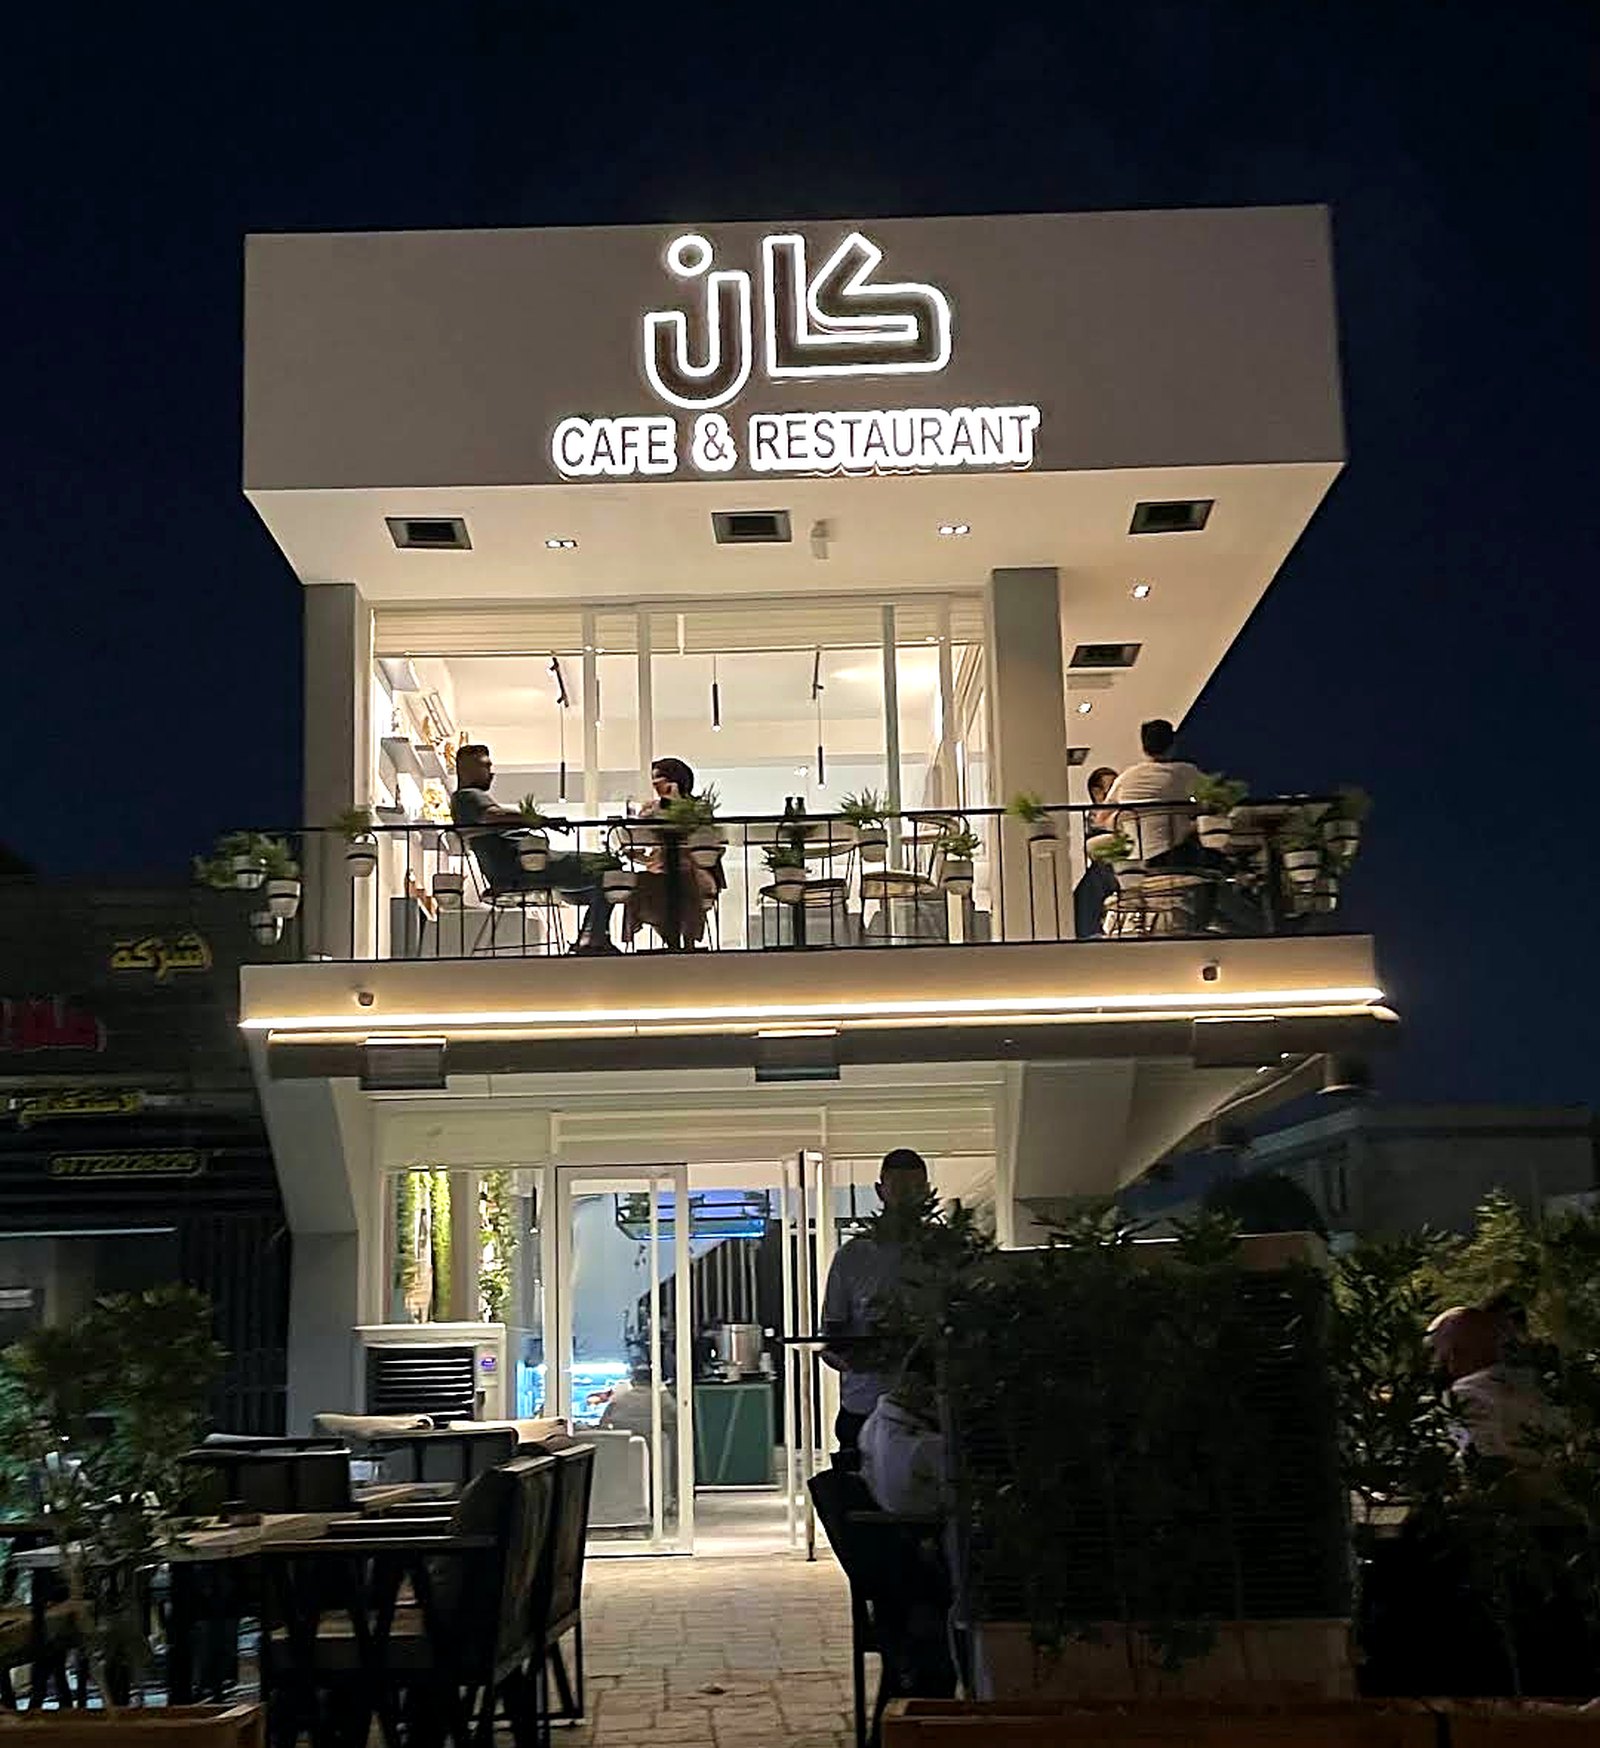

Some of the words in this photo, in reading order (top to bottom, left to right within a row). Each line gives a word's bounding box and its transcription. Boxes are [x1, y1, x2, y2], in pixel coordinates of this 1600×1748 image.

[555, 416, 676, 475] CAFE
[695, 415, 735, 470] &
[750, 407, 1038, 469] RESTAURANT
